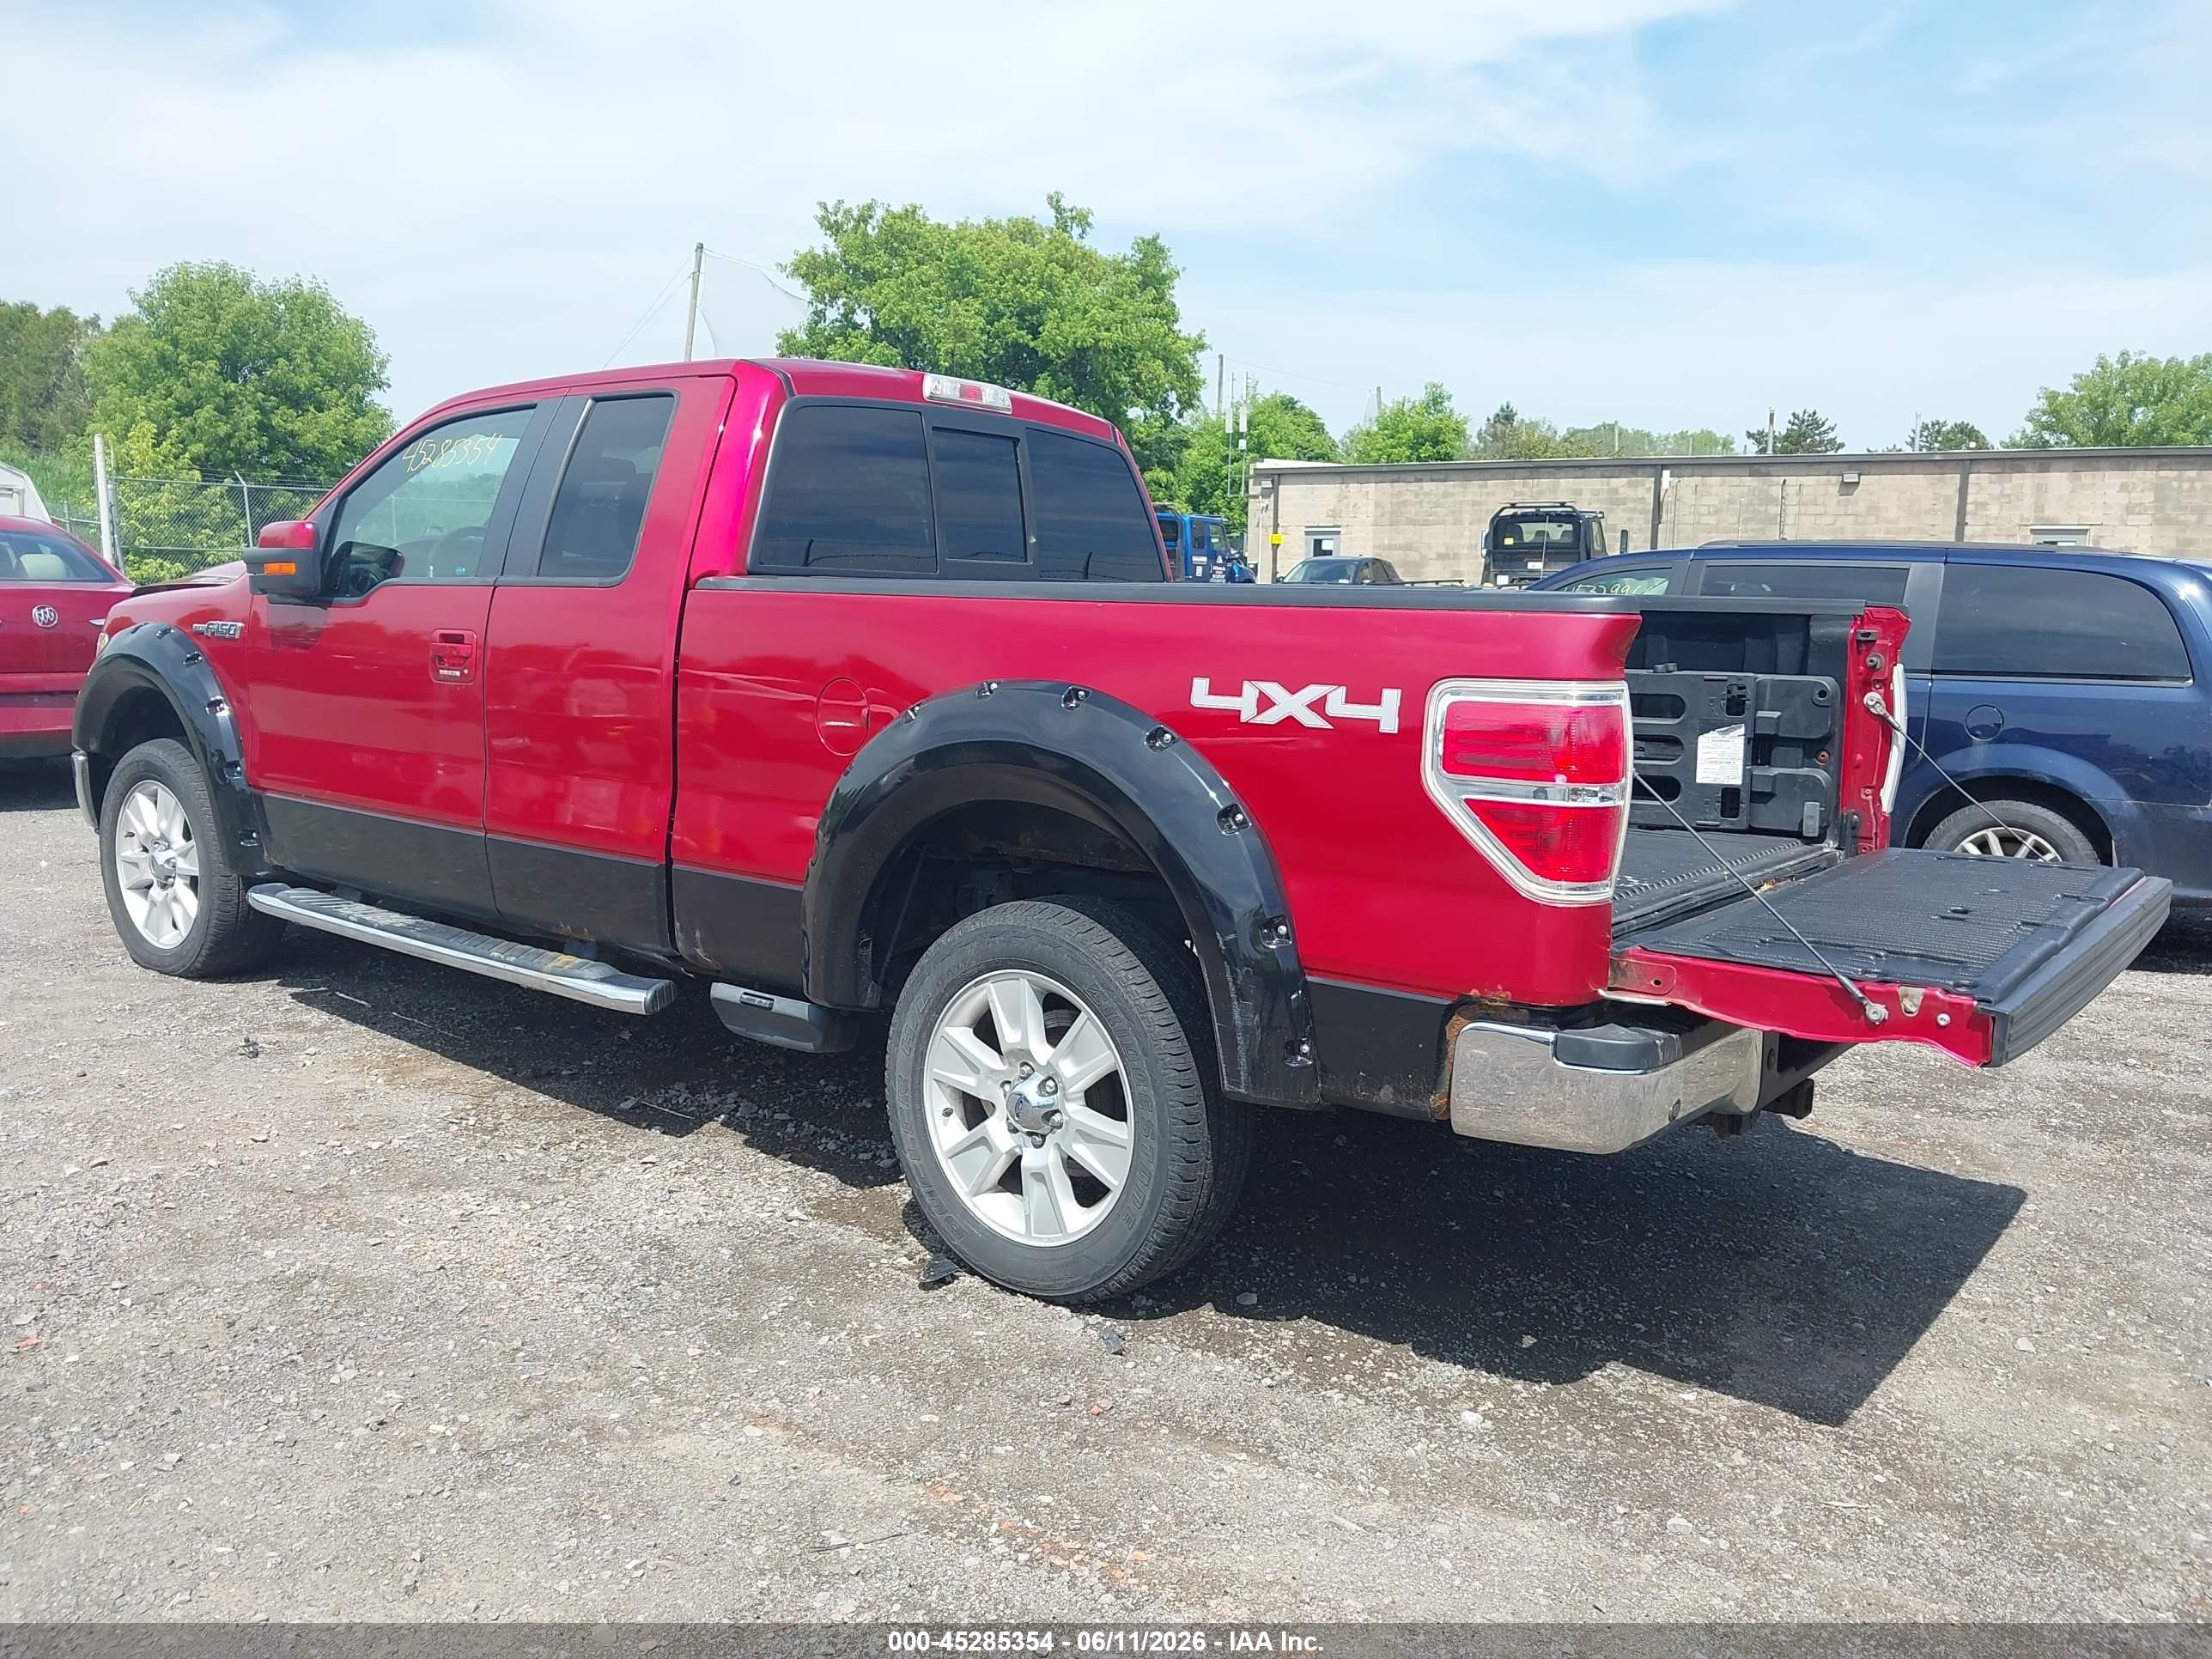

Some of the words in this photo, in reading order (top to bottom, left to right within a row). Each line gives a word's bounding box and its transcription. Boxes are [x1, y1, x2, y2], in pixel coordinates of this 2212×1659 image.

[403, 433, 502, 472] 45285354
[1191, 678, 1401, 733] 4X4
[1085, 984, 1155, 1231] BRIDGESTONE
